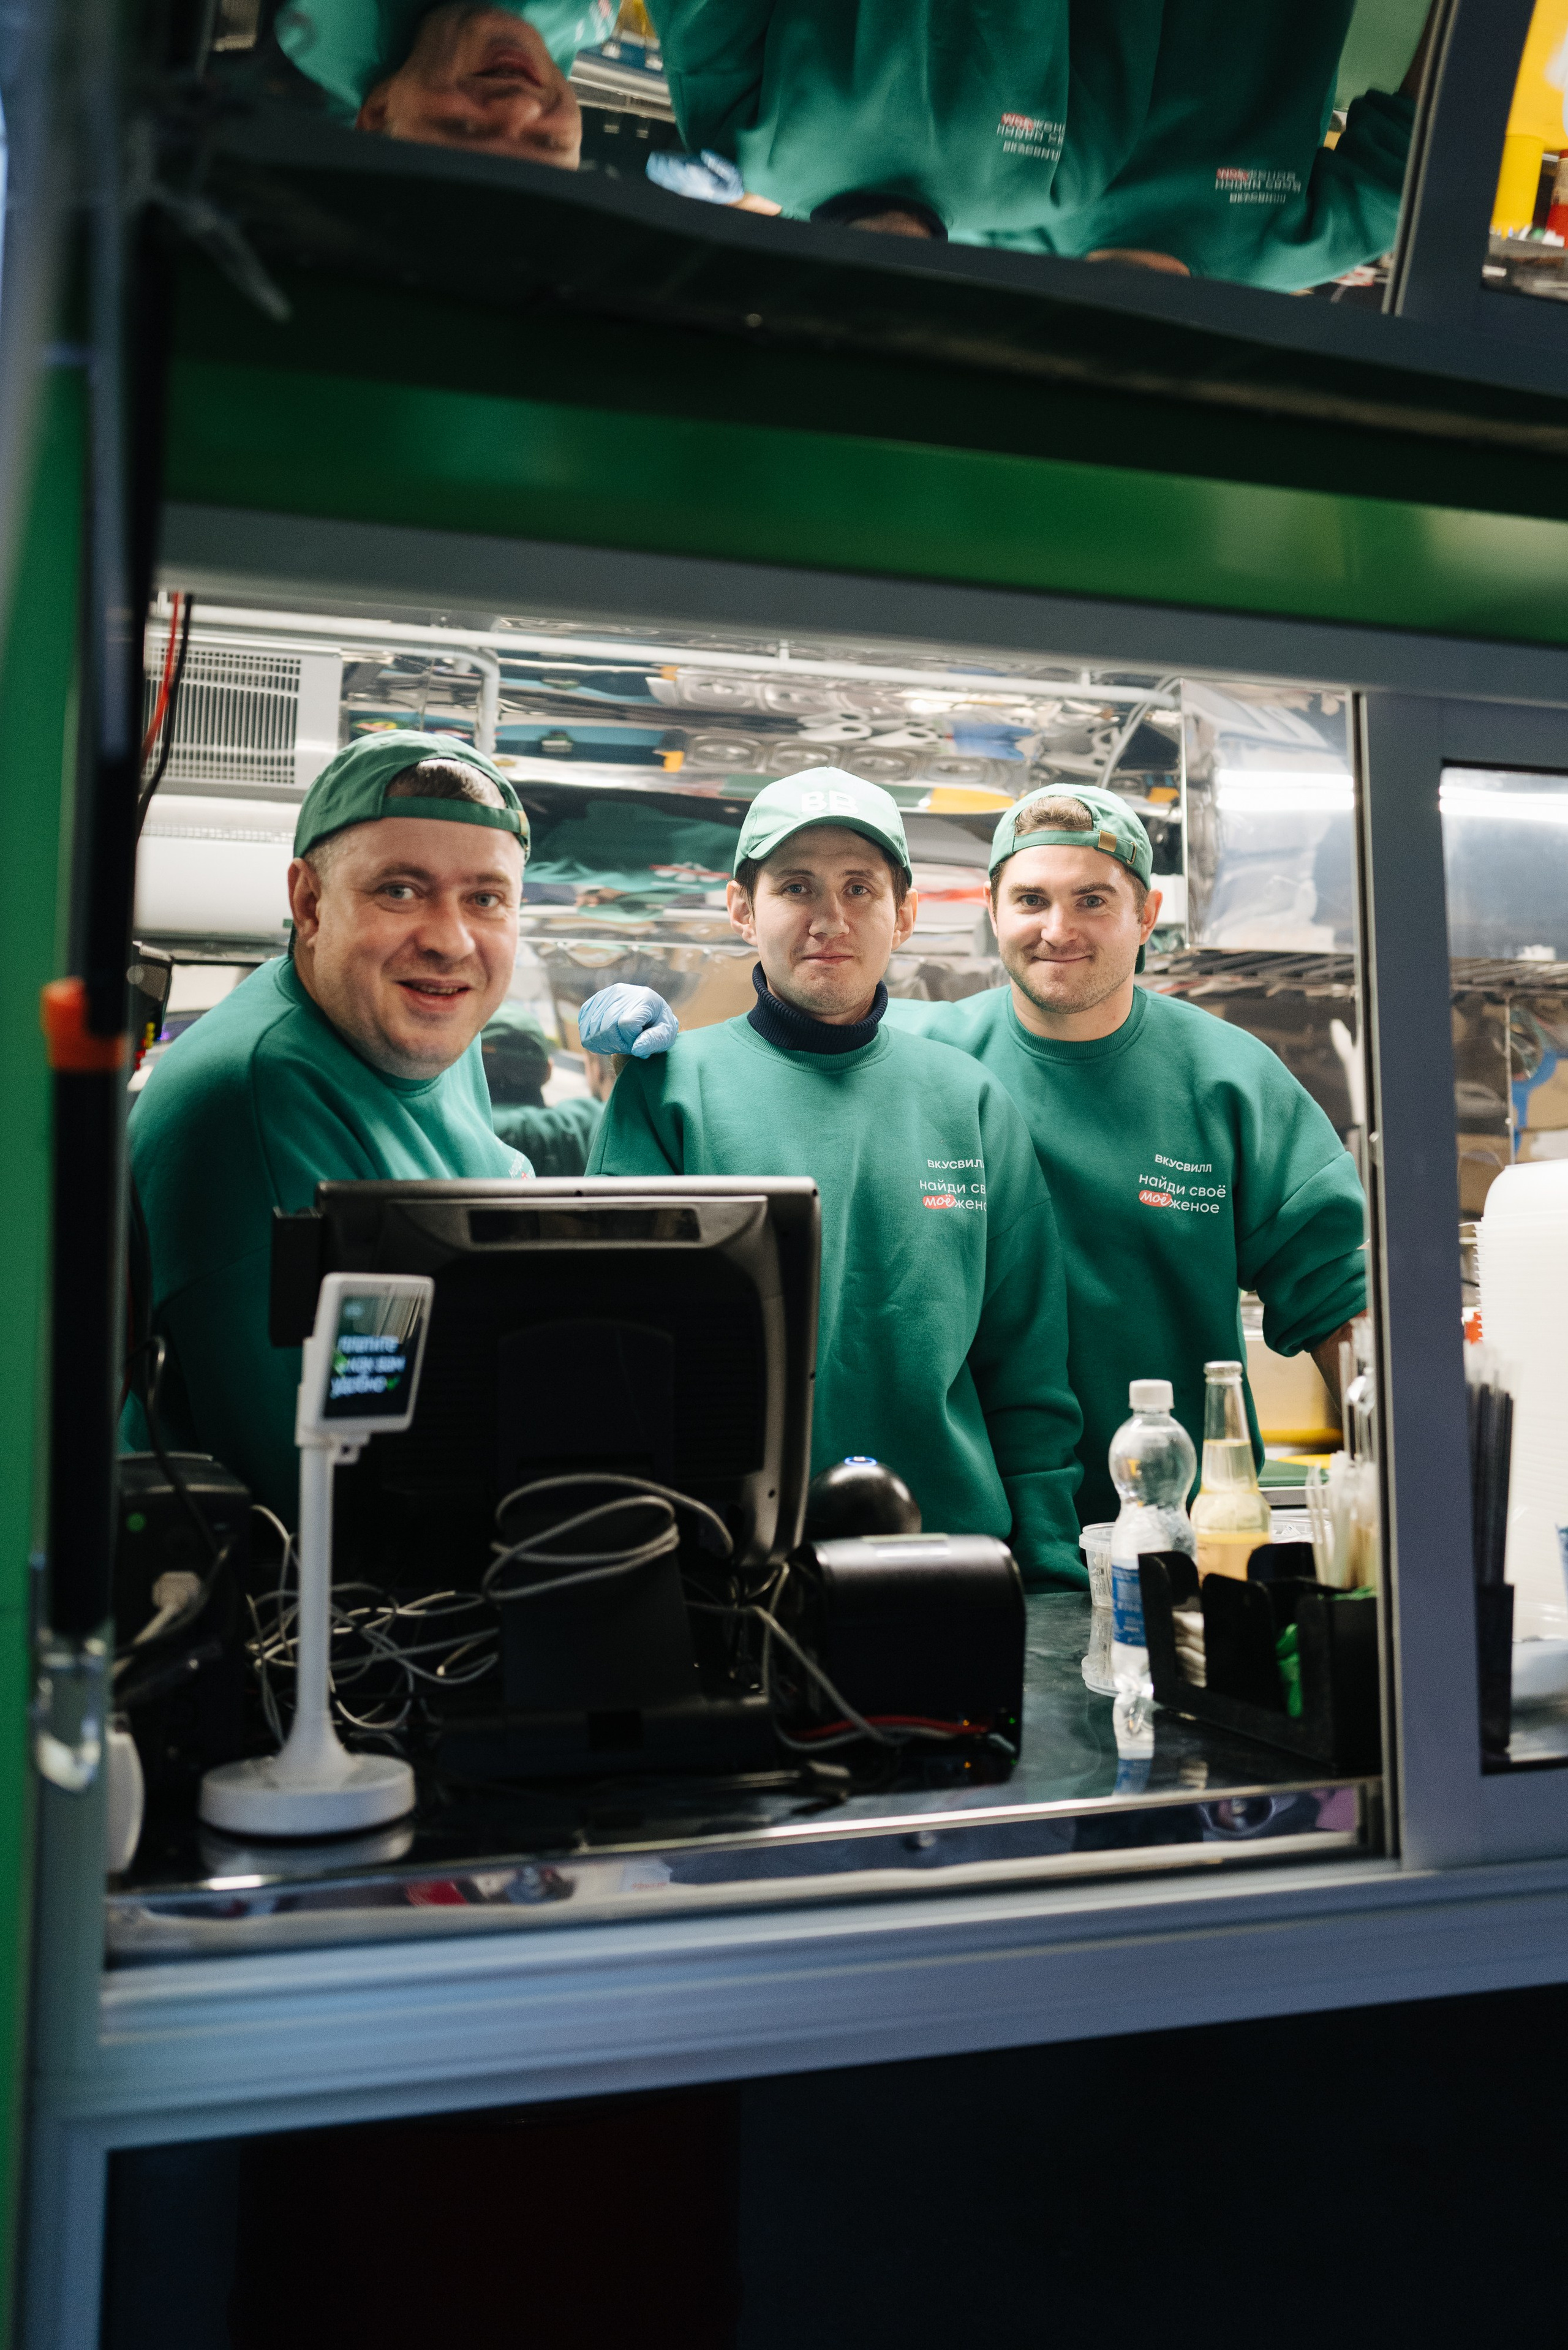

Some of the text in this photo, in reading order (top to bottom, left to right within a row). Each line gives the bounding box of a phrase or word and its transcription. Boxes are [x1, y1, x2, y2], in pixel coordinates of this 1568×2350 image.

[919, 1179, 986, 1194] найди св
[1139, 1174, 1226, 1198] найди своё
[1140, 1191, 1219, 1213] моёженое
